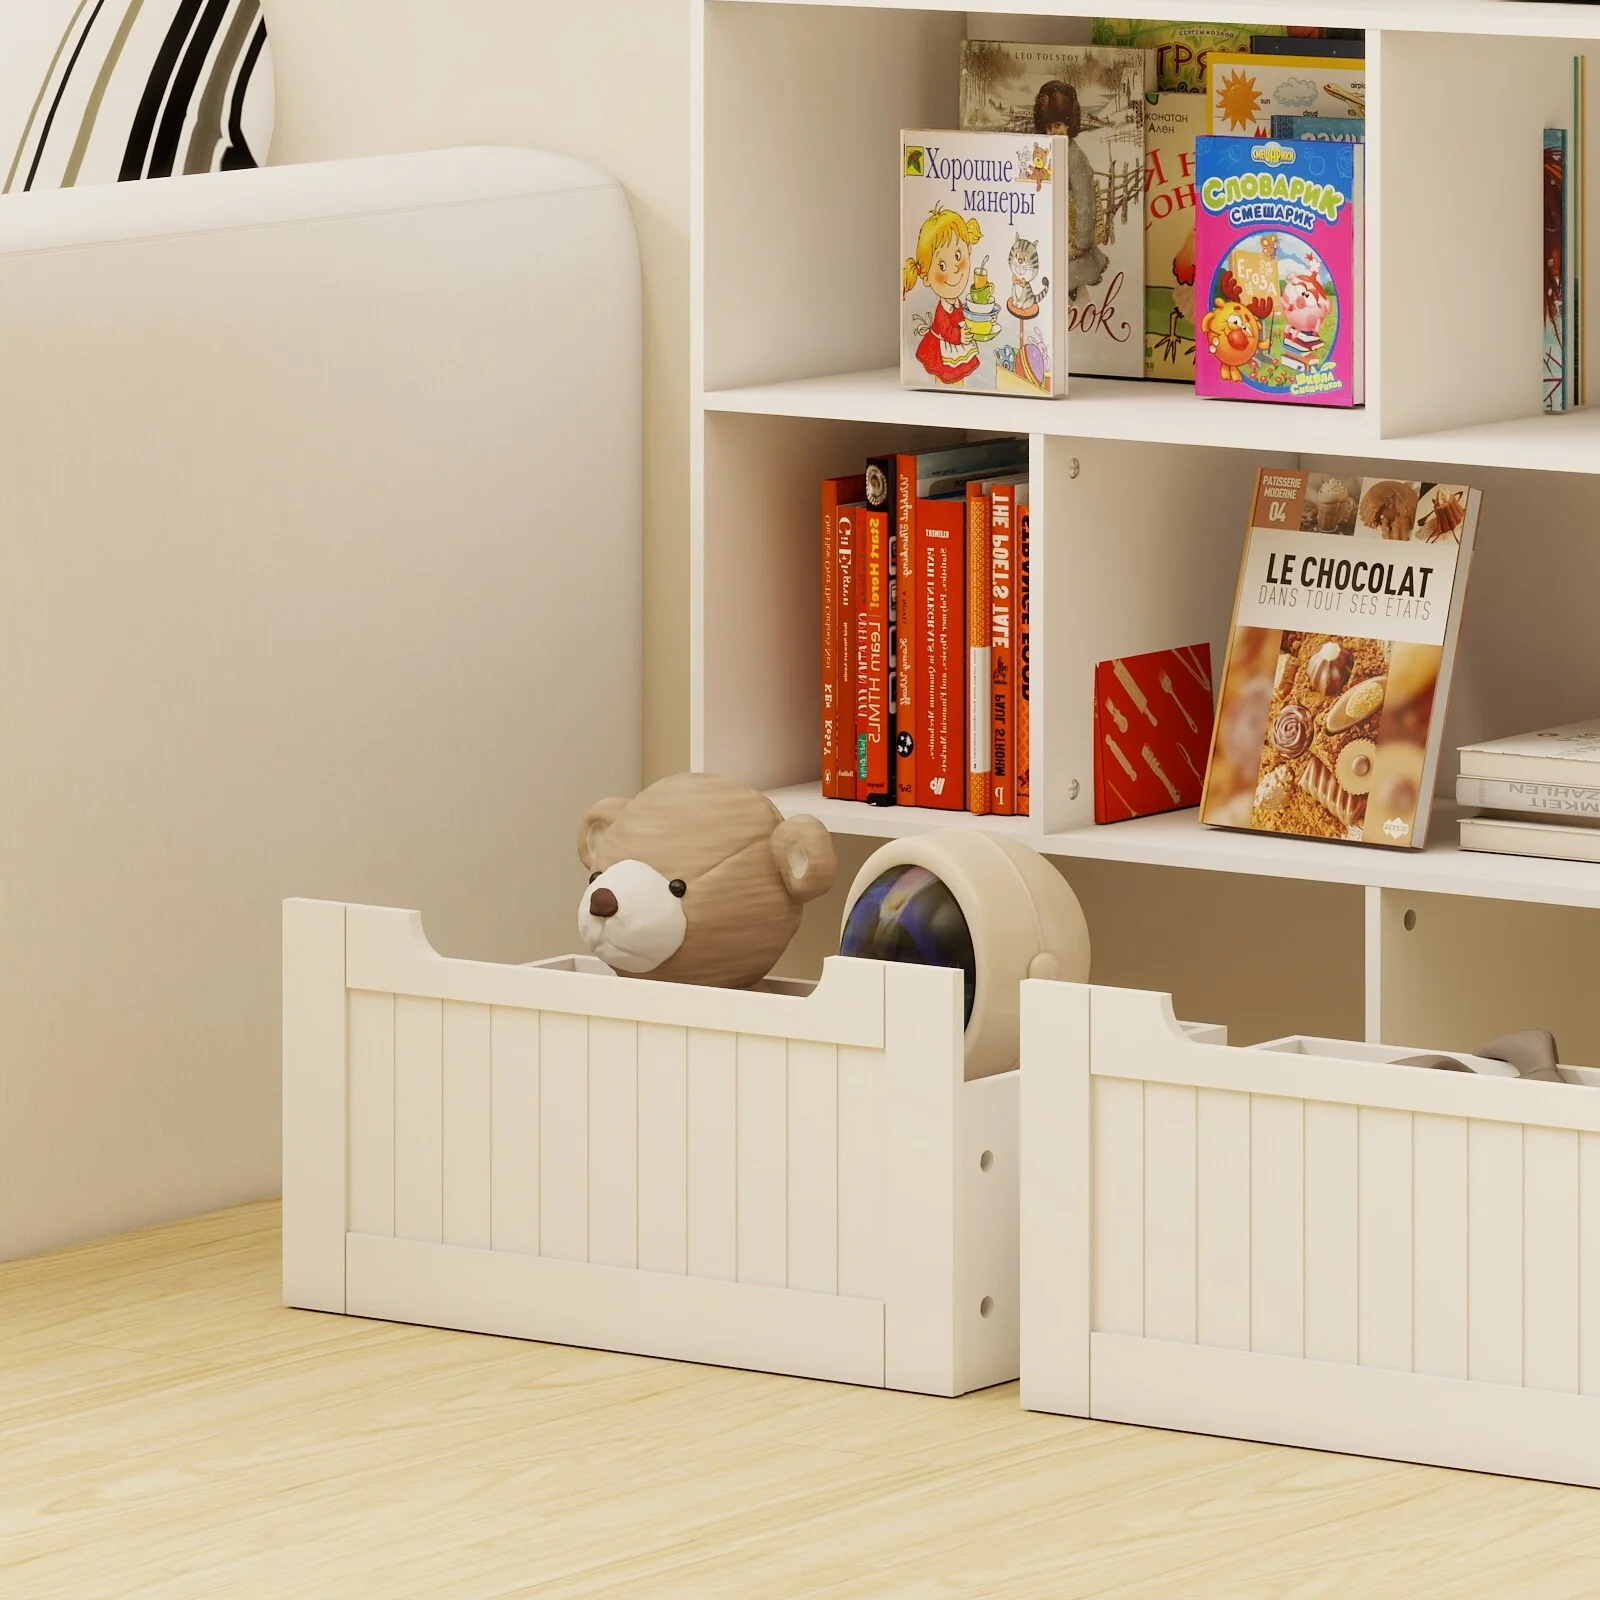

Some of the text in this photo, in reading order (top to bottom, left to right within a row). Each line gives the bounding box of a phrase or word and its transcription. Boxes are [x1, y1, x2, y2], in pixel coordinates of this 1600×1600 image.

[1015, 52, 1080, 62] LEO TOLSTOY
[925, 147, 1013, 191] Хорошие
[963, 189, 1036, 226] манеры
[1201, 173, 1345, 222] СЛОВАРИК
[1230, 204, 1316, 229] СМЕШАРИК
[1262, 475, 1302, 488] PATISSERIE
[1263, 487, 1297, 499] MODERNE
[1268, 501, 1286, 522] 04
[1266, 553, 1433, 598] LE CHOCOLAT
[1259, 585, 1298, 607] DANS
[1306, 589, 1343, 611] TOUT
[1349, 593, 1377, 615] SES
